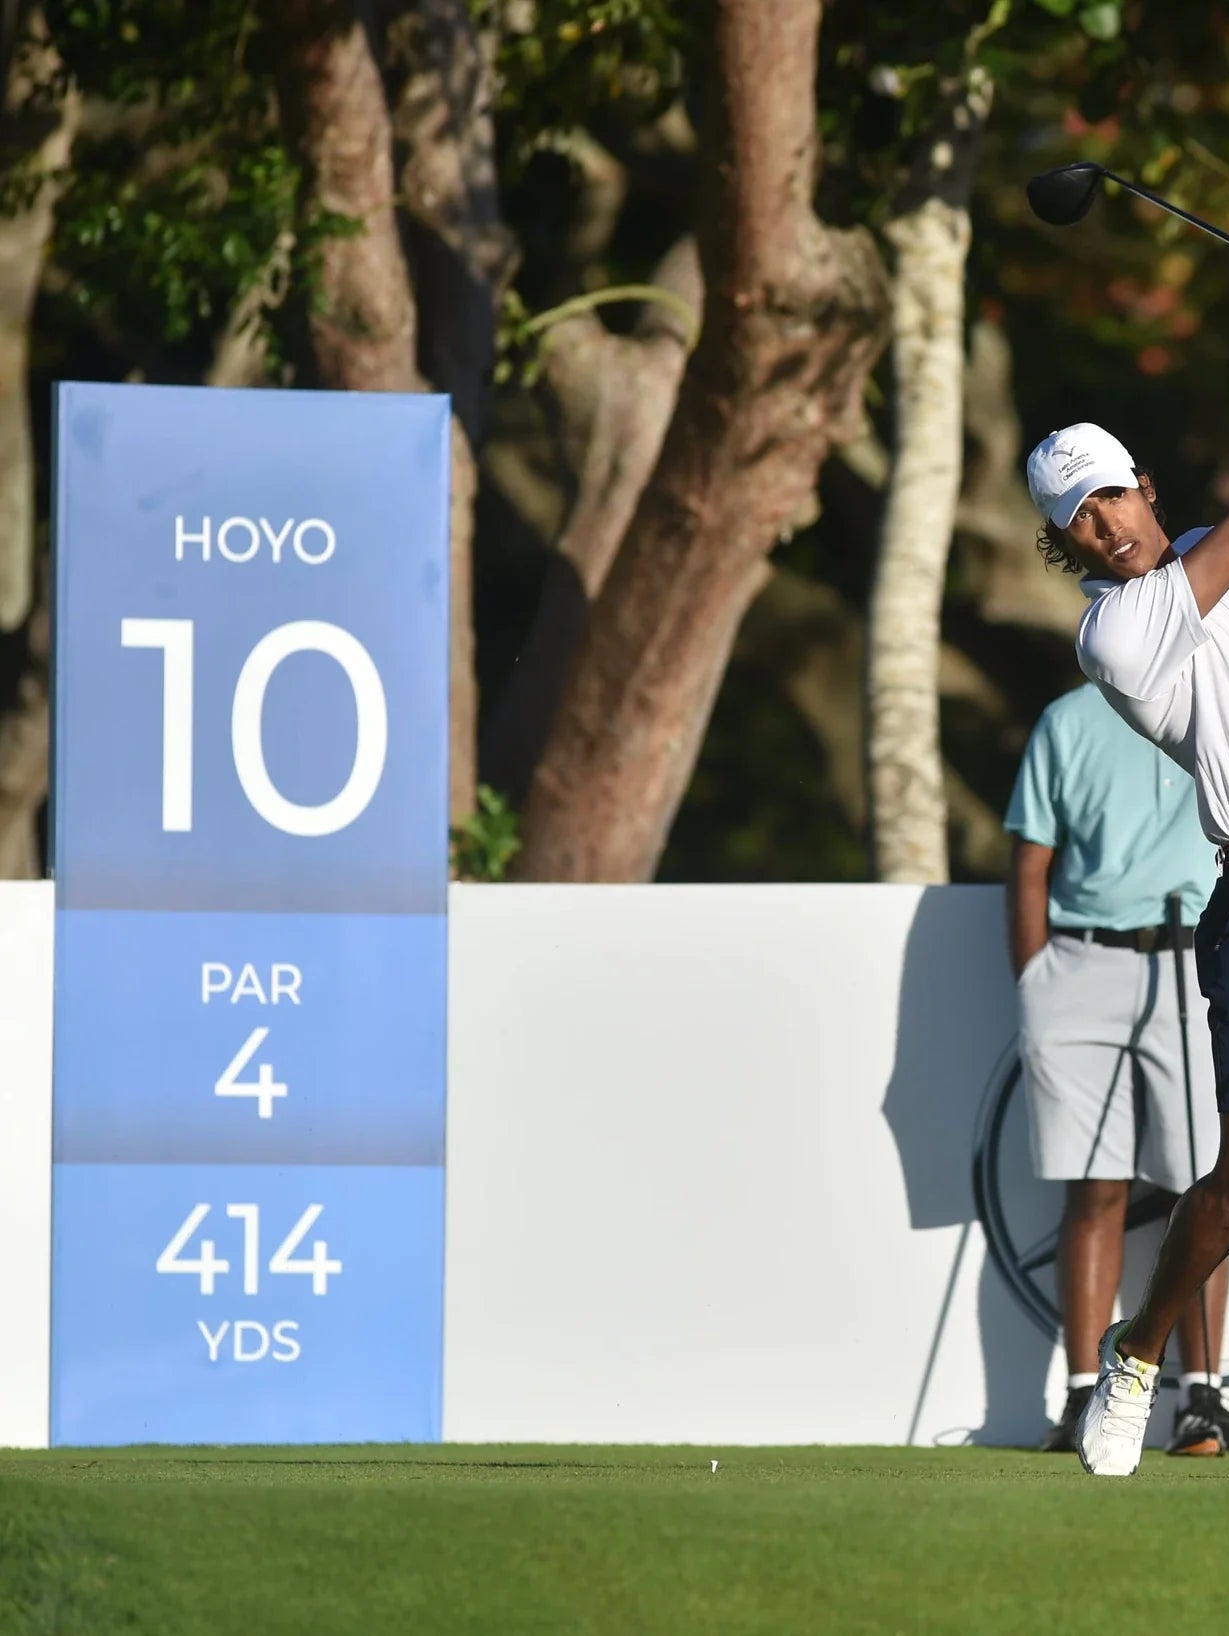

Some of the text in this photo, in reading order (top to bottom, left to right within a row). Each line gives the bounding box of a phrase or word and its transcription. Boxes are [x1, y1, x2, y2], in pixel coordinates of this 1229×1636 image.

[175, 516, 336, 565] HOYO
[121, 618, 388, 836] 10
[201, 963, 302, 1005] PAR
[214, 1027, 288, 1119] 4
[156, 1203, 342, 1295] 414
[198, 1321, 301, 1363] YDS
